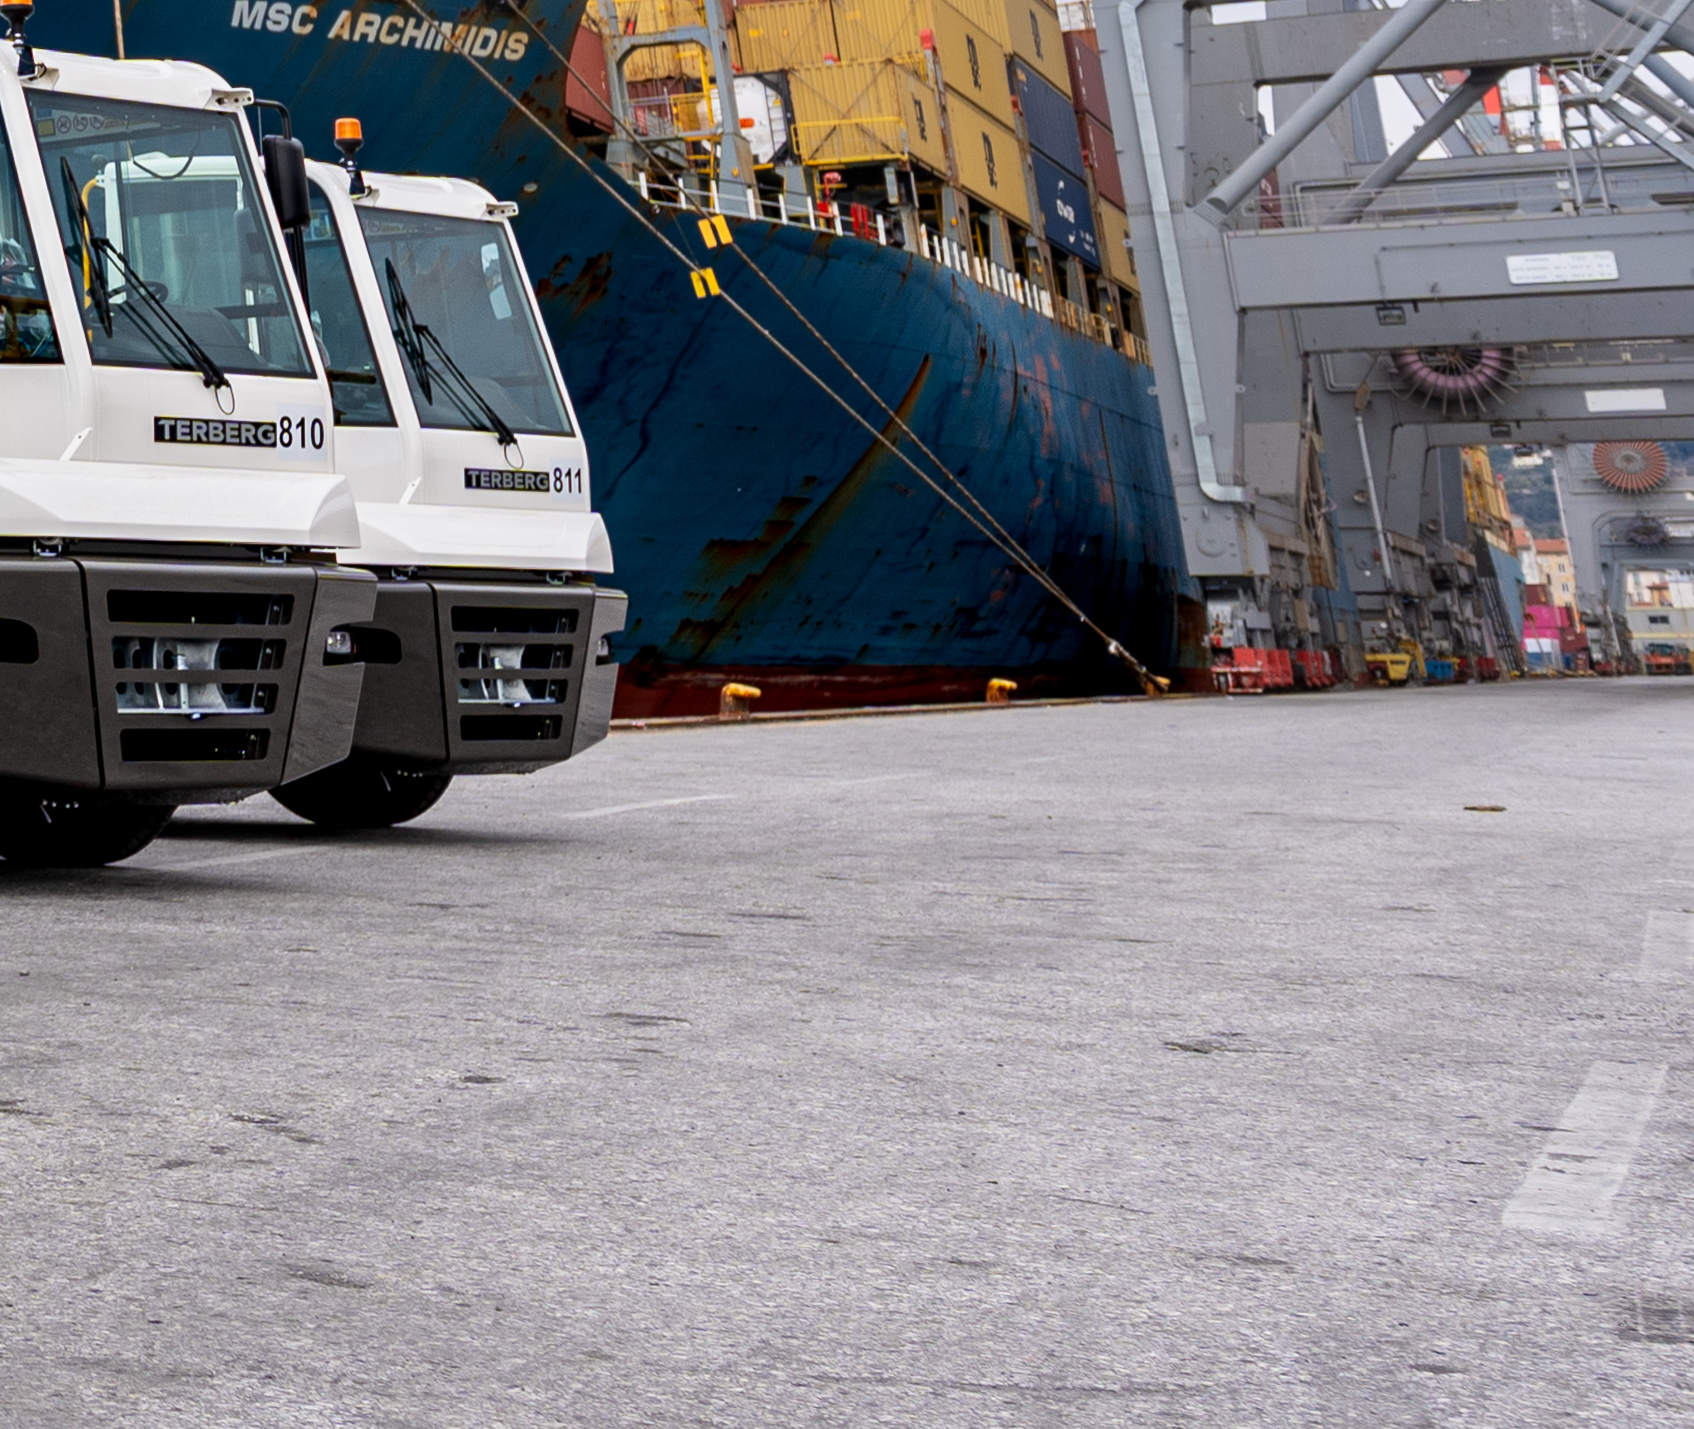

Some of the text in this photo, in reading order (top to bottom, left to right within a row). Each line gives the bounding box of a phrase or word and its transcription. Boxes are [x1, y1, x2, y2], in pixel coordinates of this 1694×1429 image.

[230, 0, 530, 62] MSC ARCHIMIDIS
[157, 415, 325, 450] TERBERG 810
[467, 467, 582, 494] TERBERG 811
